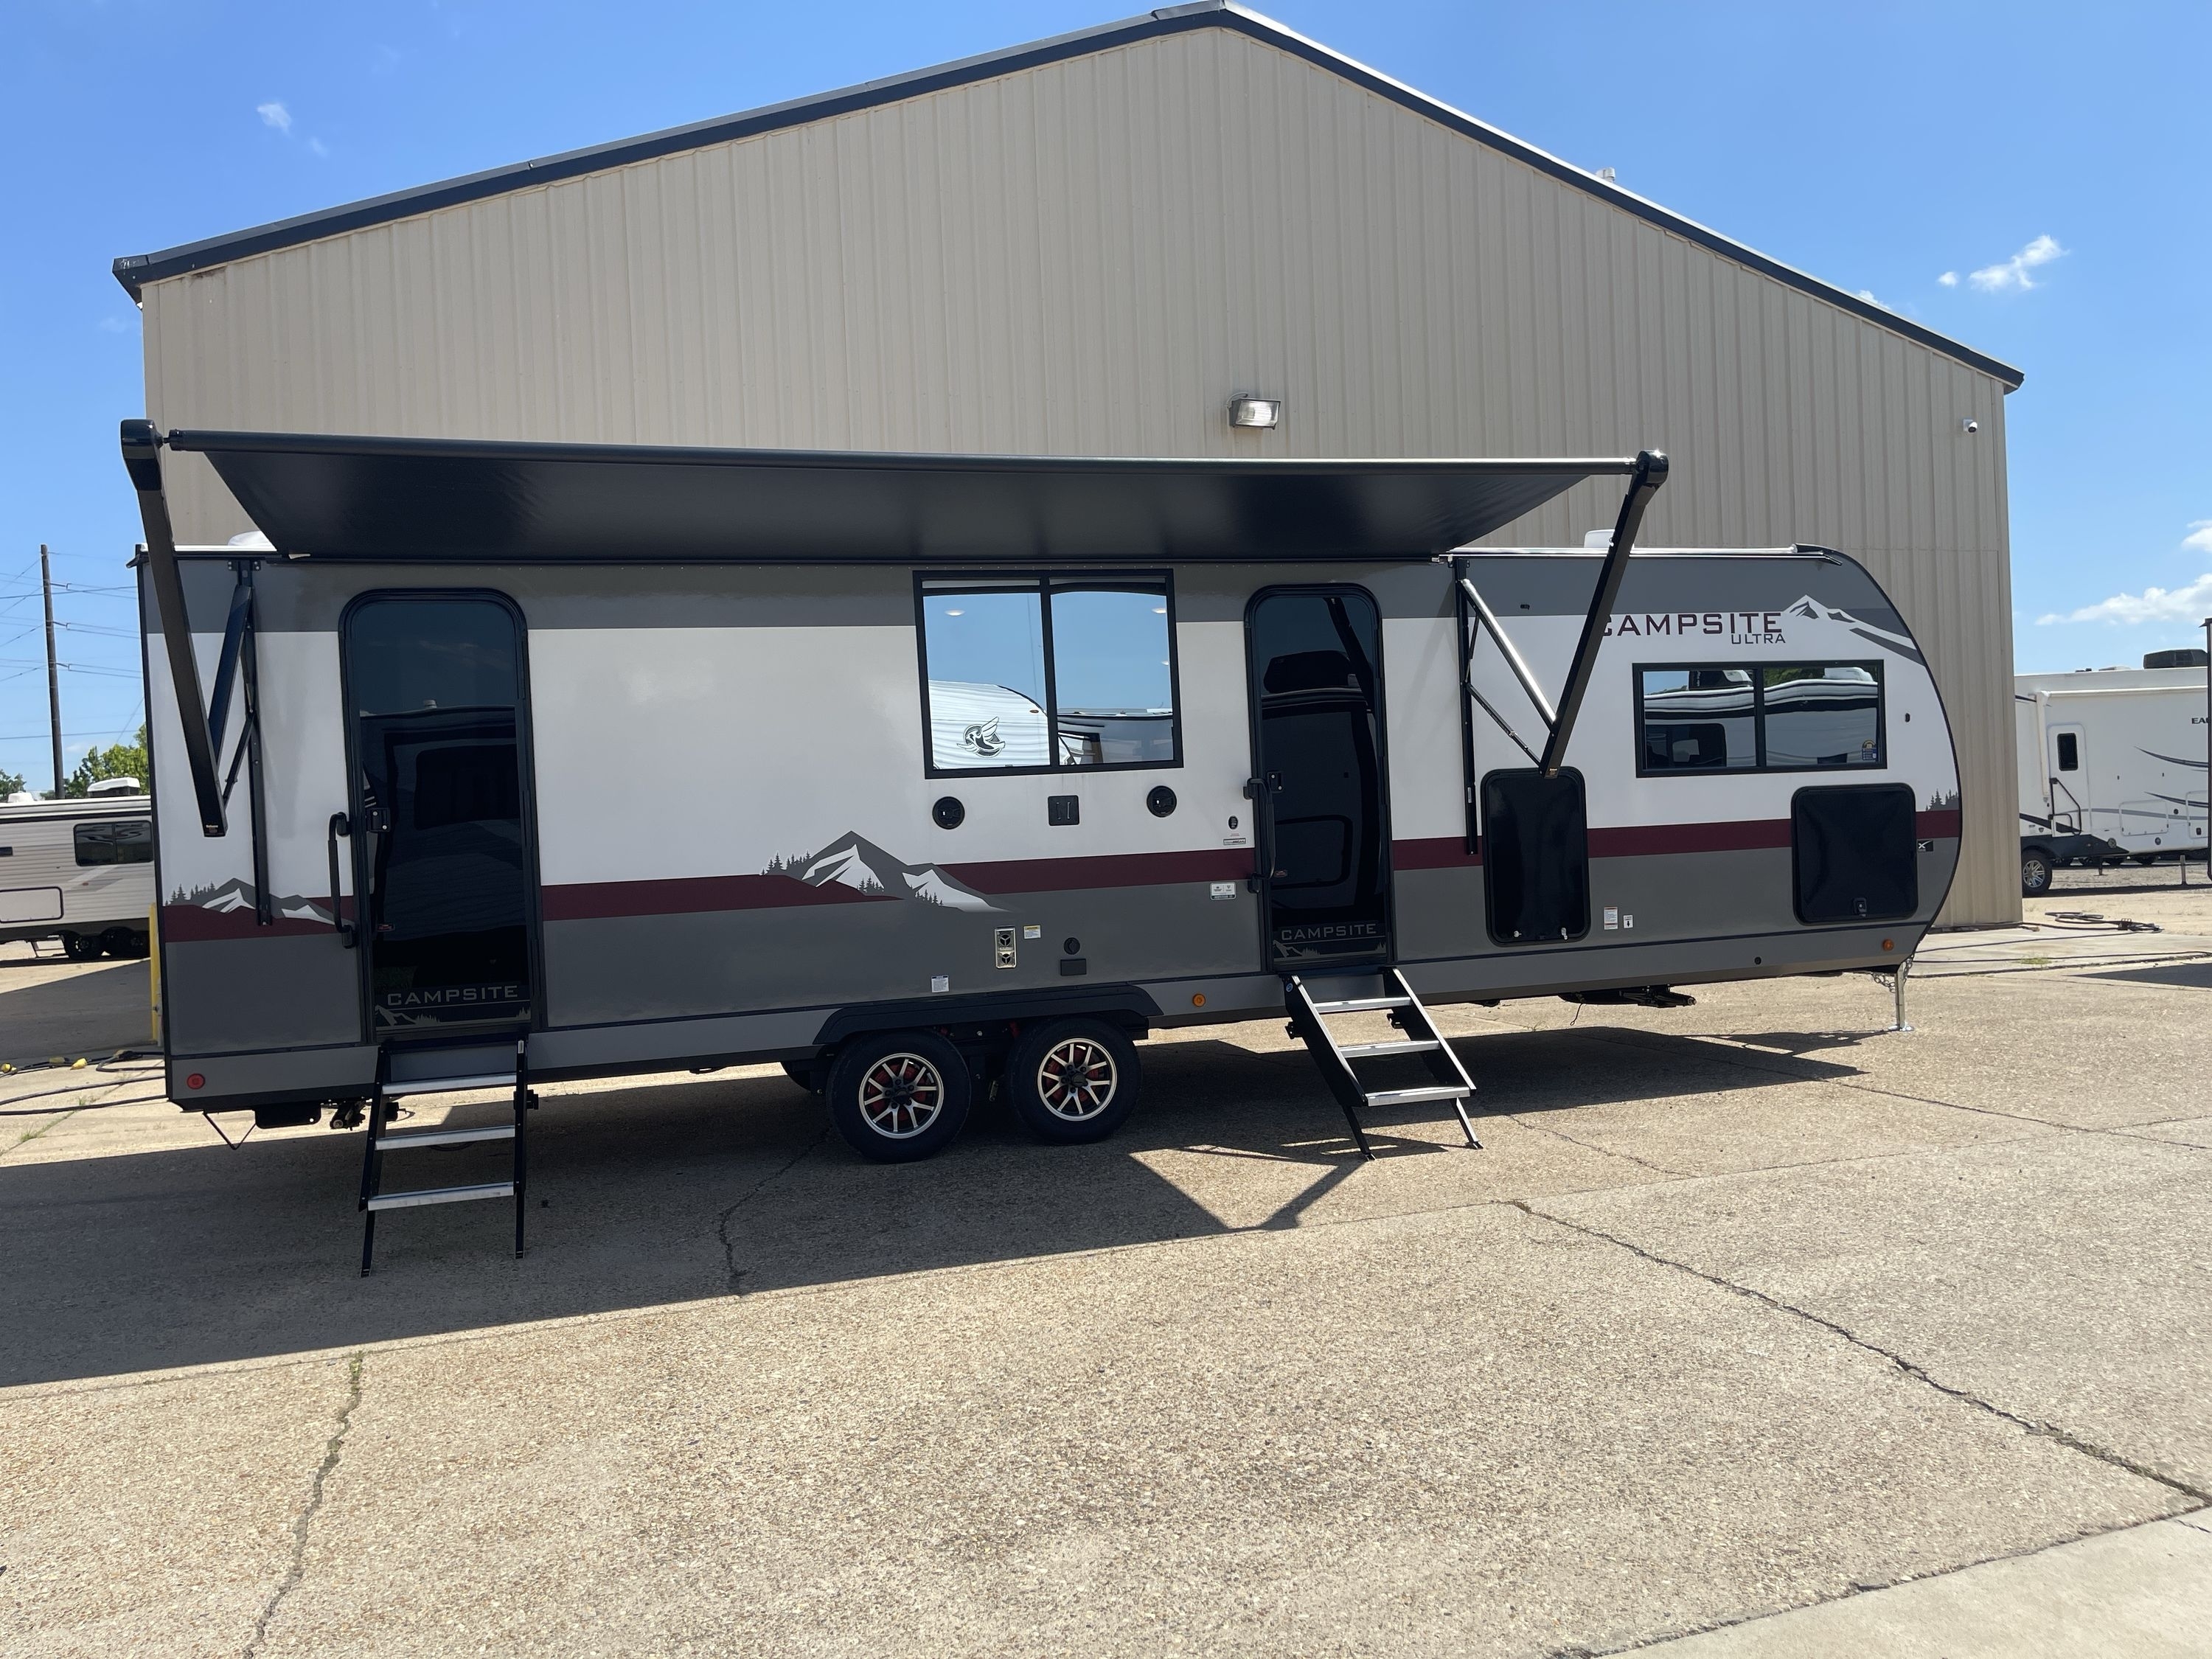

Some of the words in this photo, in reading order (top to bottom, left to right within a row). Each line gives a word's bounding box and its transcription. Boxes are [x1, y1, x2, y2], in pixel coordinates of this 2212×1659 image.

[1731, 633, 1786, 644] ULTRA
[1281, 923, 1377, 941] CAMPSITE
[387, 985, 518, 1006] CAMPSITE
